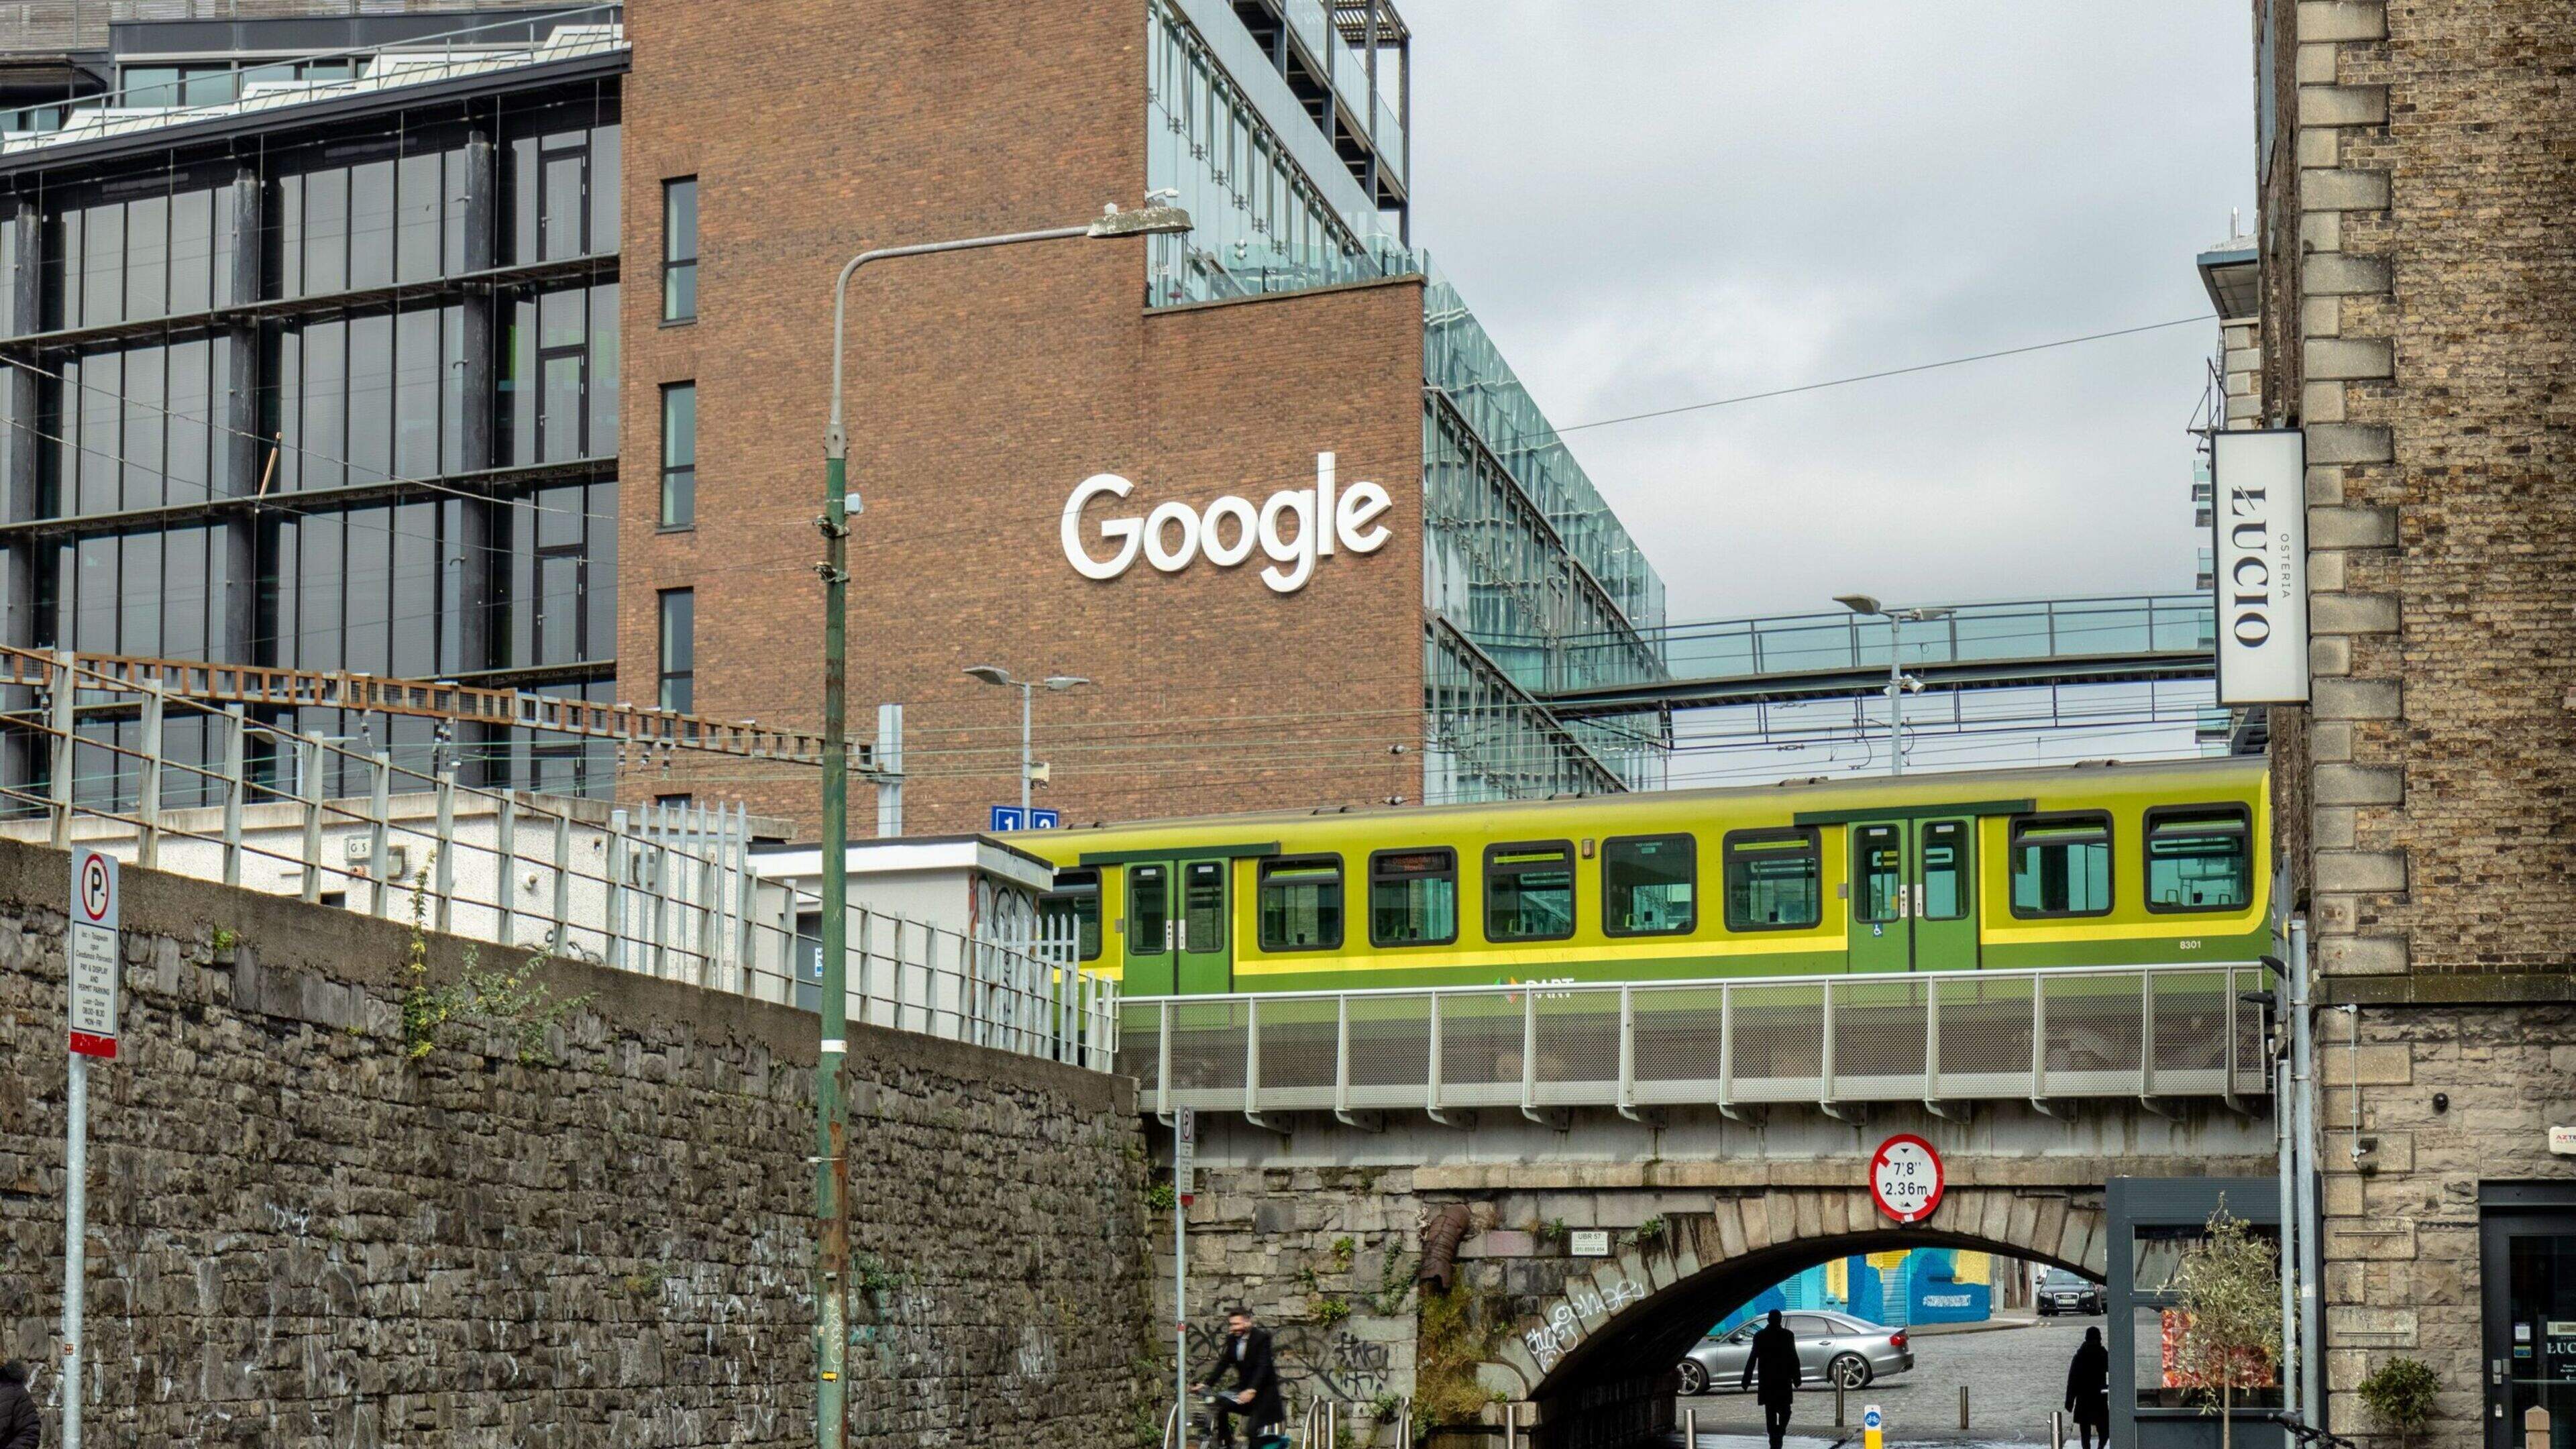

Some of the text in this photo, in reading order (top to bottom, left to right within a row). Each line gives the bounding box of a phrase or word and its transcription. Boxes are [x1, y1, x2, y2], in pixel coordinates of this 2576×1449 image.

[1061, 451, 1393, 593] Google
[2280, 533, 2291, 599] OSTERIA
[1004, 816, 1014, 831] 1
[91, 866, 102, 907] P
[2180, 941, 2201, 949] 8301
[1885, 1182, 1927, 1195] 2.36m
